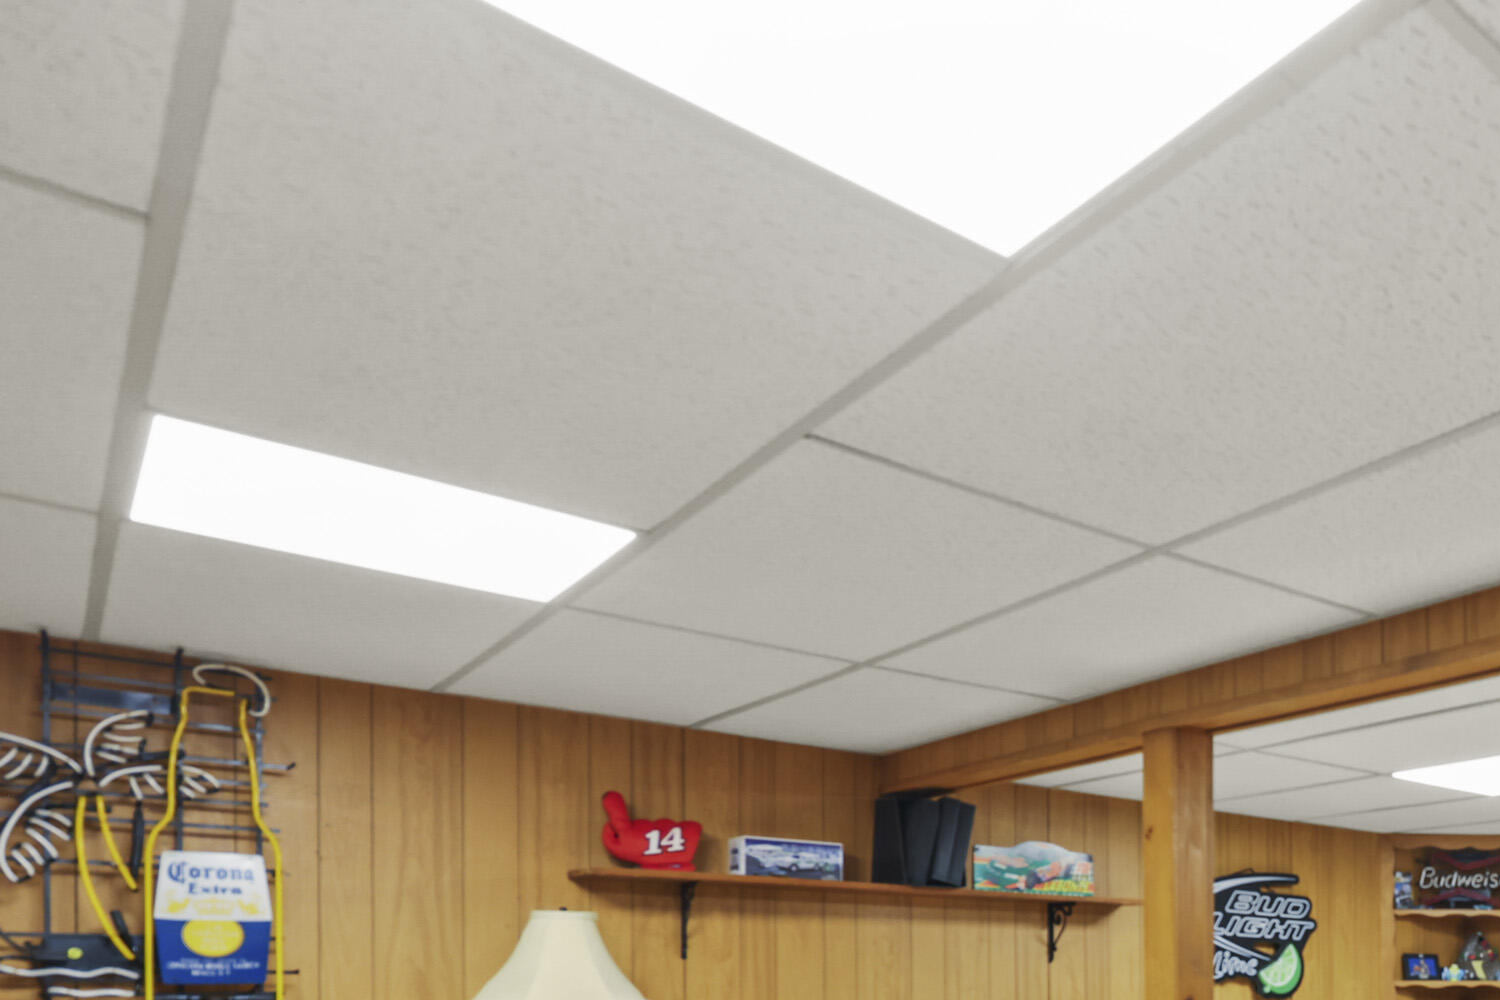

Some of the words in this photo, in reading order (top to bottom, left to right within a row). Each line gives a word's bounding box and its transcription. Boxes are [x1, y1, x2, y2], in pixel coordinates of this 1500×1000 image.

[643, 827, 686, 856] 14
[168, 861, 255, 884] Corona
[188, 883, 243, 895] Extra
[1225, 889, 1311, 919] BUD
[1213, 912, 1316, 941] LIGHT
